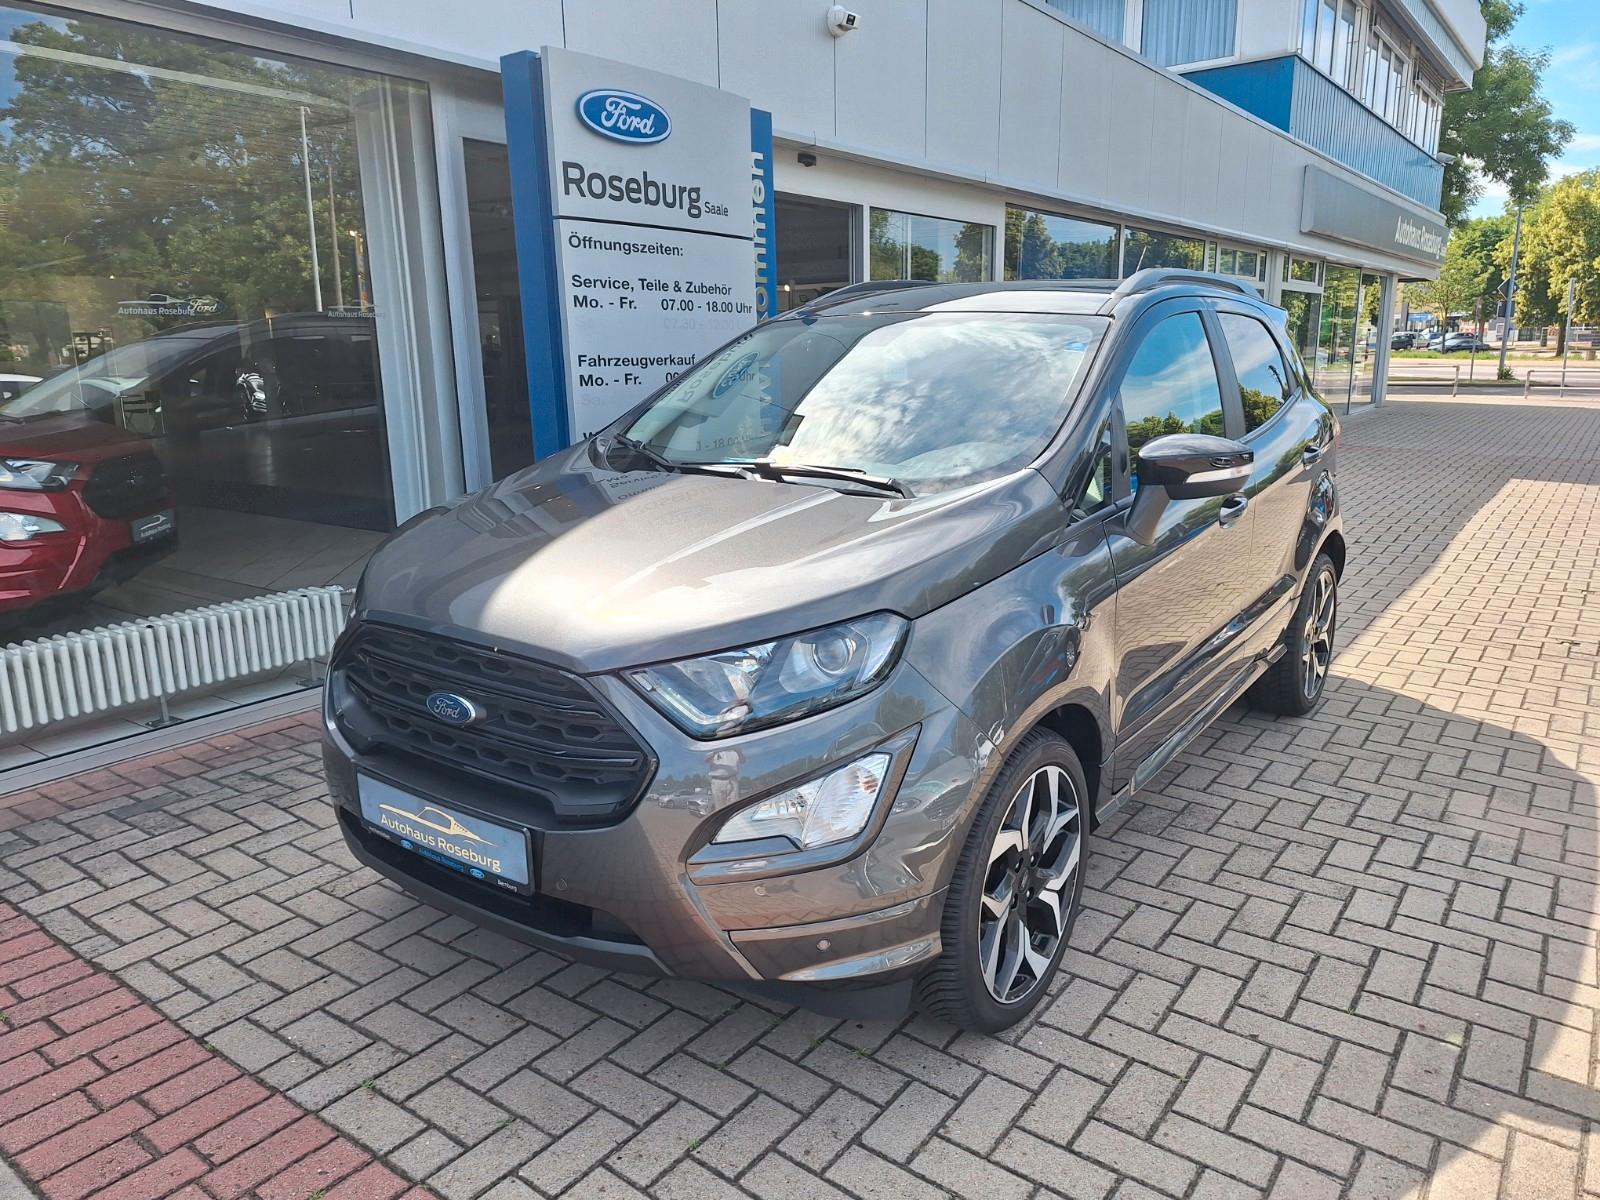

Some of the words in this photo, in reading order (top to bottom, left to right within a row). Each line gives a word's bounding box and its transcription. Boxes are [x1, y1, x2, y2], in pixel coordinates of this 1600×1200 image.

[601, 97, 655, 135] Ford
[562, 161, 702, 218] Roseburg
[704, 201, 729, 217] Saale
[568, 232, 684, 256] Öffnungszeiten:
[1394, 215, 1421, 248] Autohaus
[1420, 225, 1442, 259] Roseburg
[571, 275, 635, 292] Service,
[638, 278, 669, 291] Teile
[673, 281, 682, 292] &
[685, 281, 732, 296] Zubehör
[118, 307, 158, 315] Autohaus
[188, 299, 217, 313] Ford
[573, 295, 603, 309] Mo.
[619, 297, 637, 310] Fr.
[661, 299, 694, 311] 07.00
[706, 301, 733, 313] 18.00
[736, 302, 753, 314] Uhr
[577, 353, 696, 370] Fahrzeugverkauf
[579, 374, 609, 387] Mo.
[624, 373, 642, 386] Fr.
[434, 697, 460, 719] Ford
[381, 814, 435, 846] Autohaus
[438, 837, 501, 873] Roseburg
